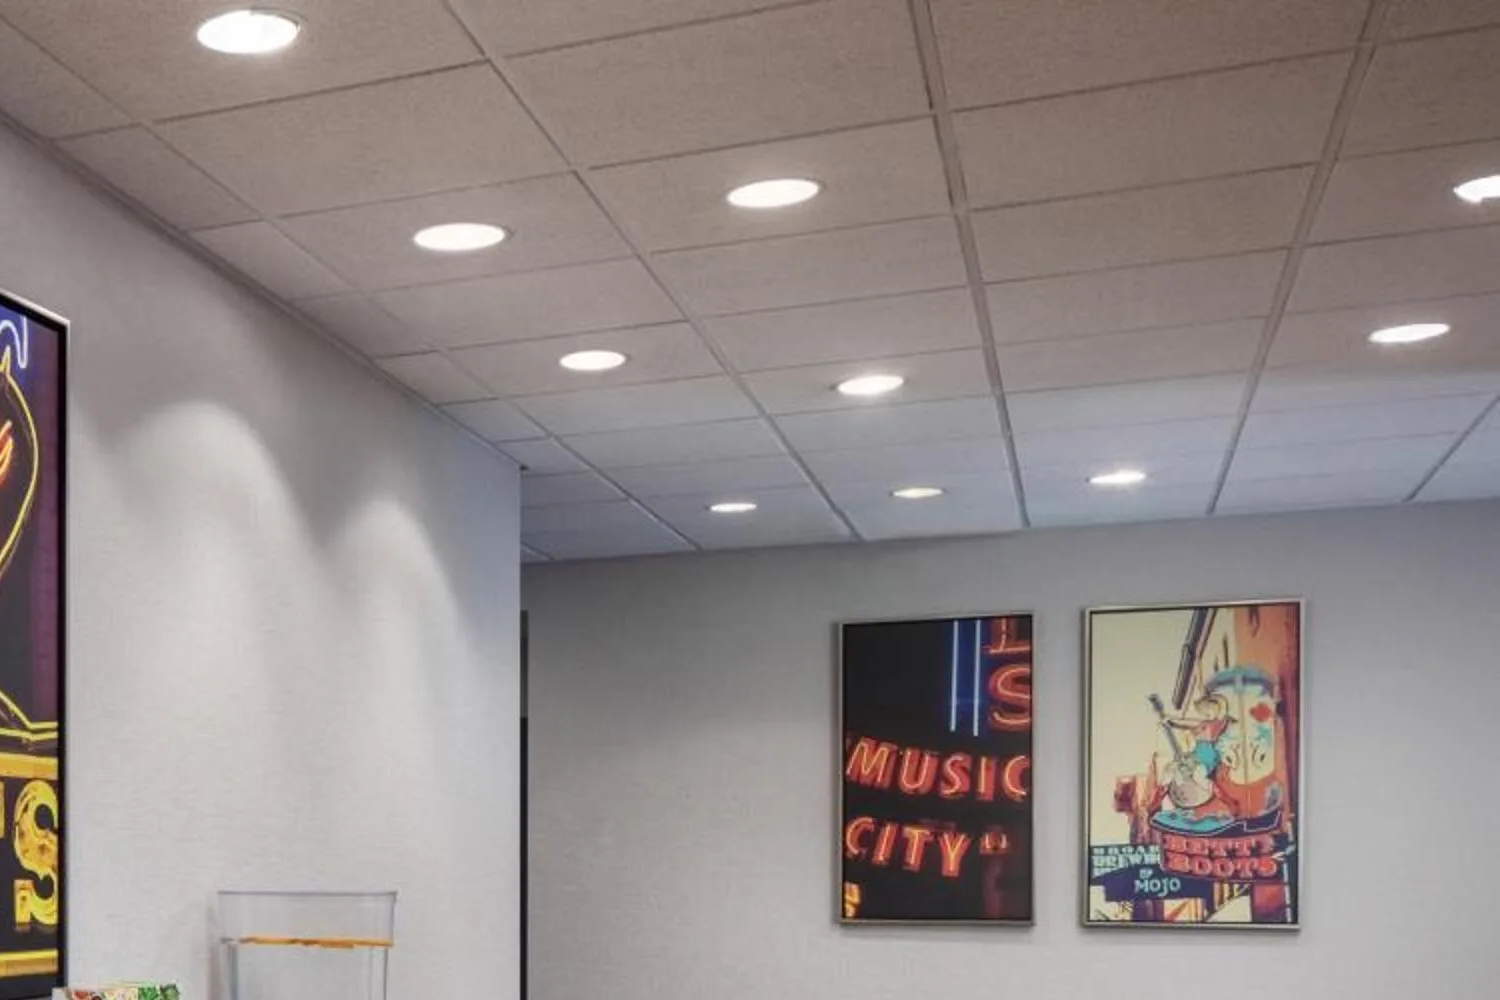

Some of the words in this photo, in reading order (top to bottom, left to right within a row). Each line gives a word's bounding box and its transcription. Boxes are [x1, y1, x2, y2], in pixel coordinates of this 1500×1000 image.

[845, 736, 1030, 801] MUSIC
[845, 816, 972, 878] CITY
[1164, 852, 1277, 880] BOOTS
[1134, 877, 1181, 897] MOJO
